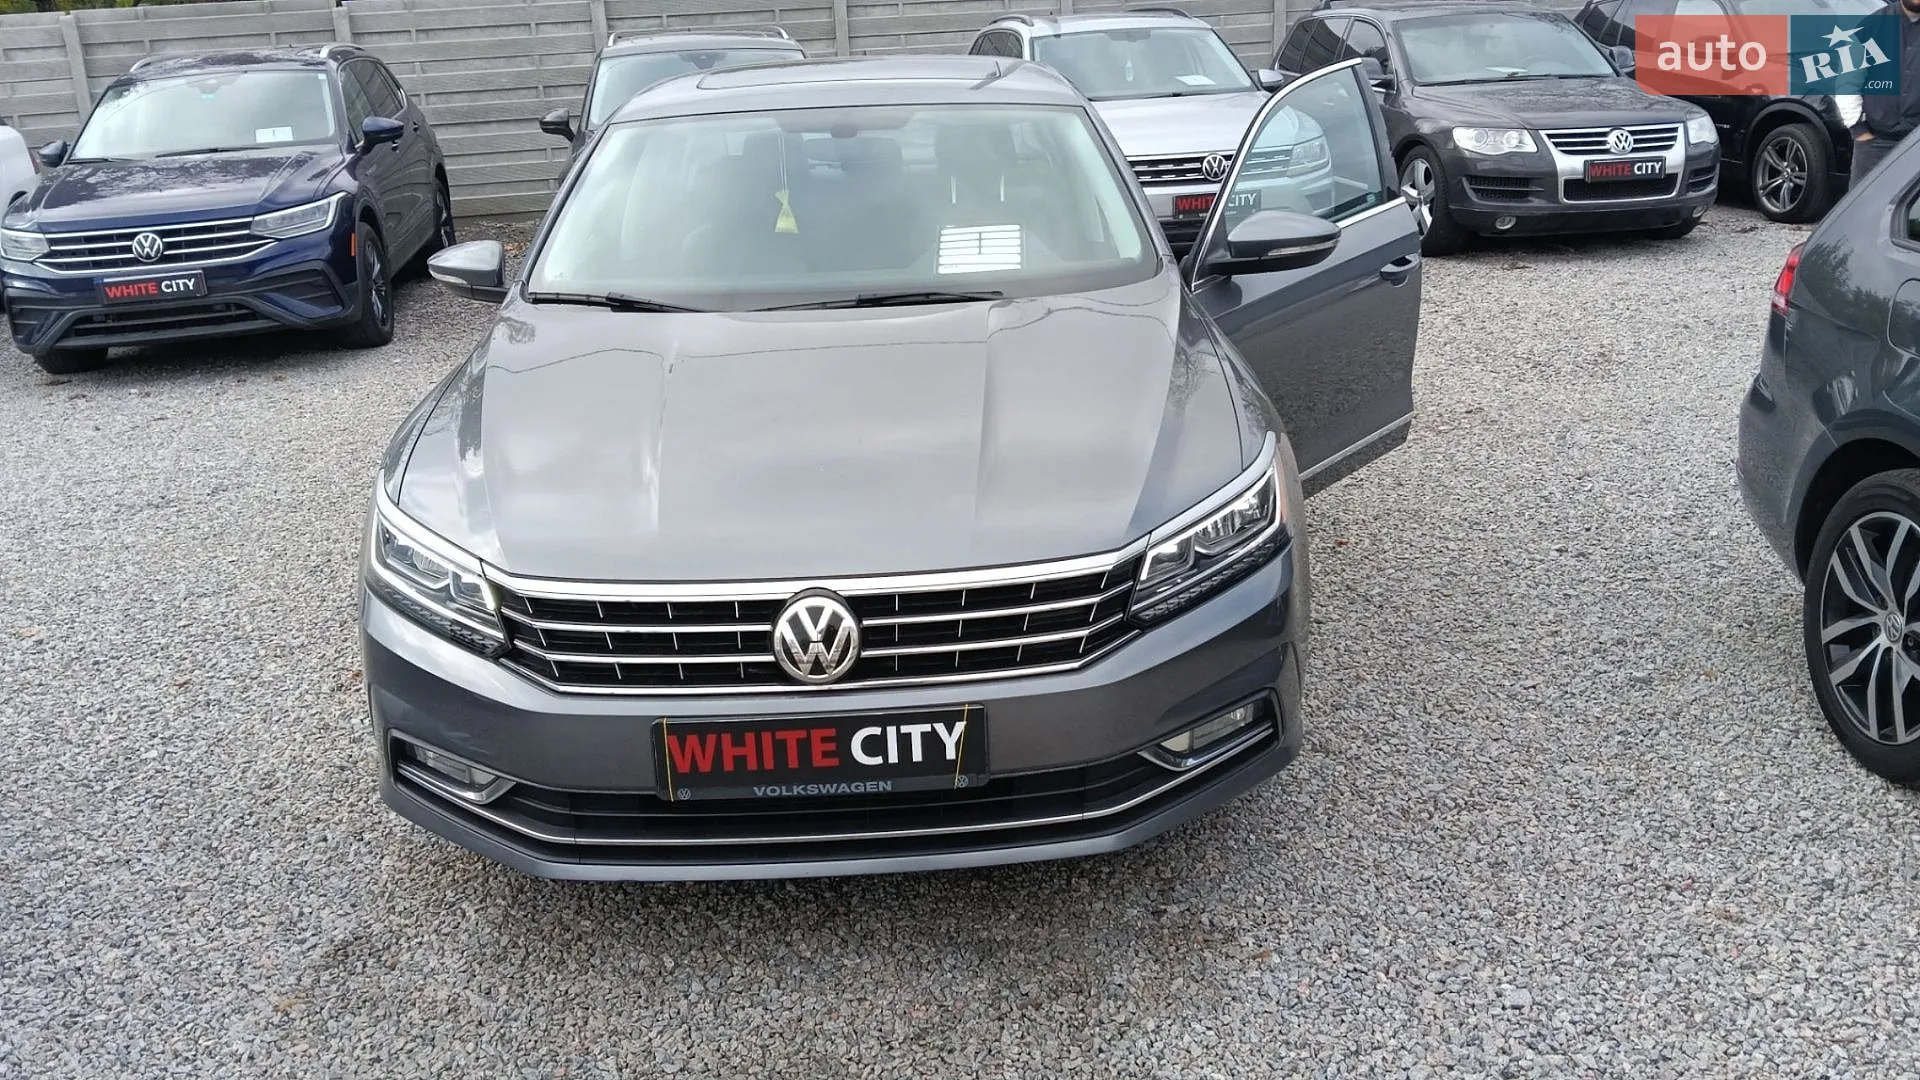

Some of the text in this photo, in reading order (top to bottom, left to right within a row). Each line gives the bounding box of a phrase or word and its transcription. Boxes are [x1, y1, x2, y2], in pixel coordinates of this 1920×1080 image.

[1590, 161, 1662, 177] WHITE CITY
[105, 278, 196, 299] WHITE CITY
[667, 721, 967, 774] WHITE CITY
[753, 780, 892, 797] VOLKSWAGEN
